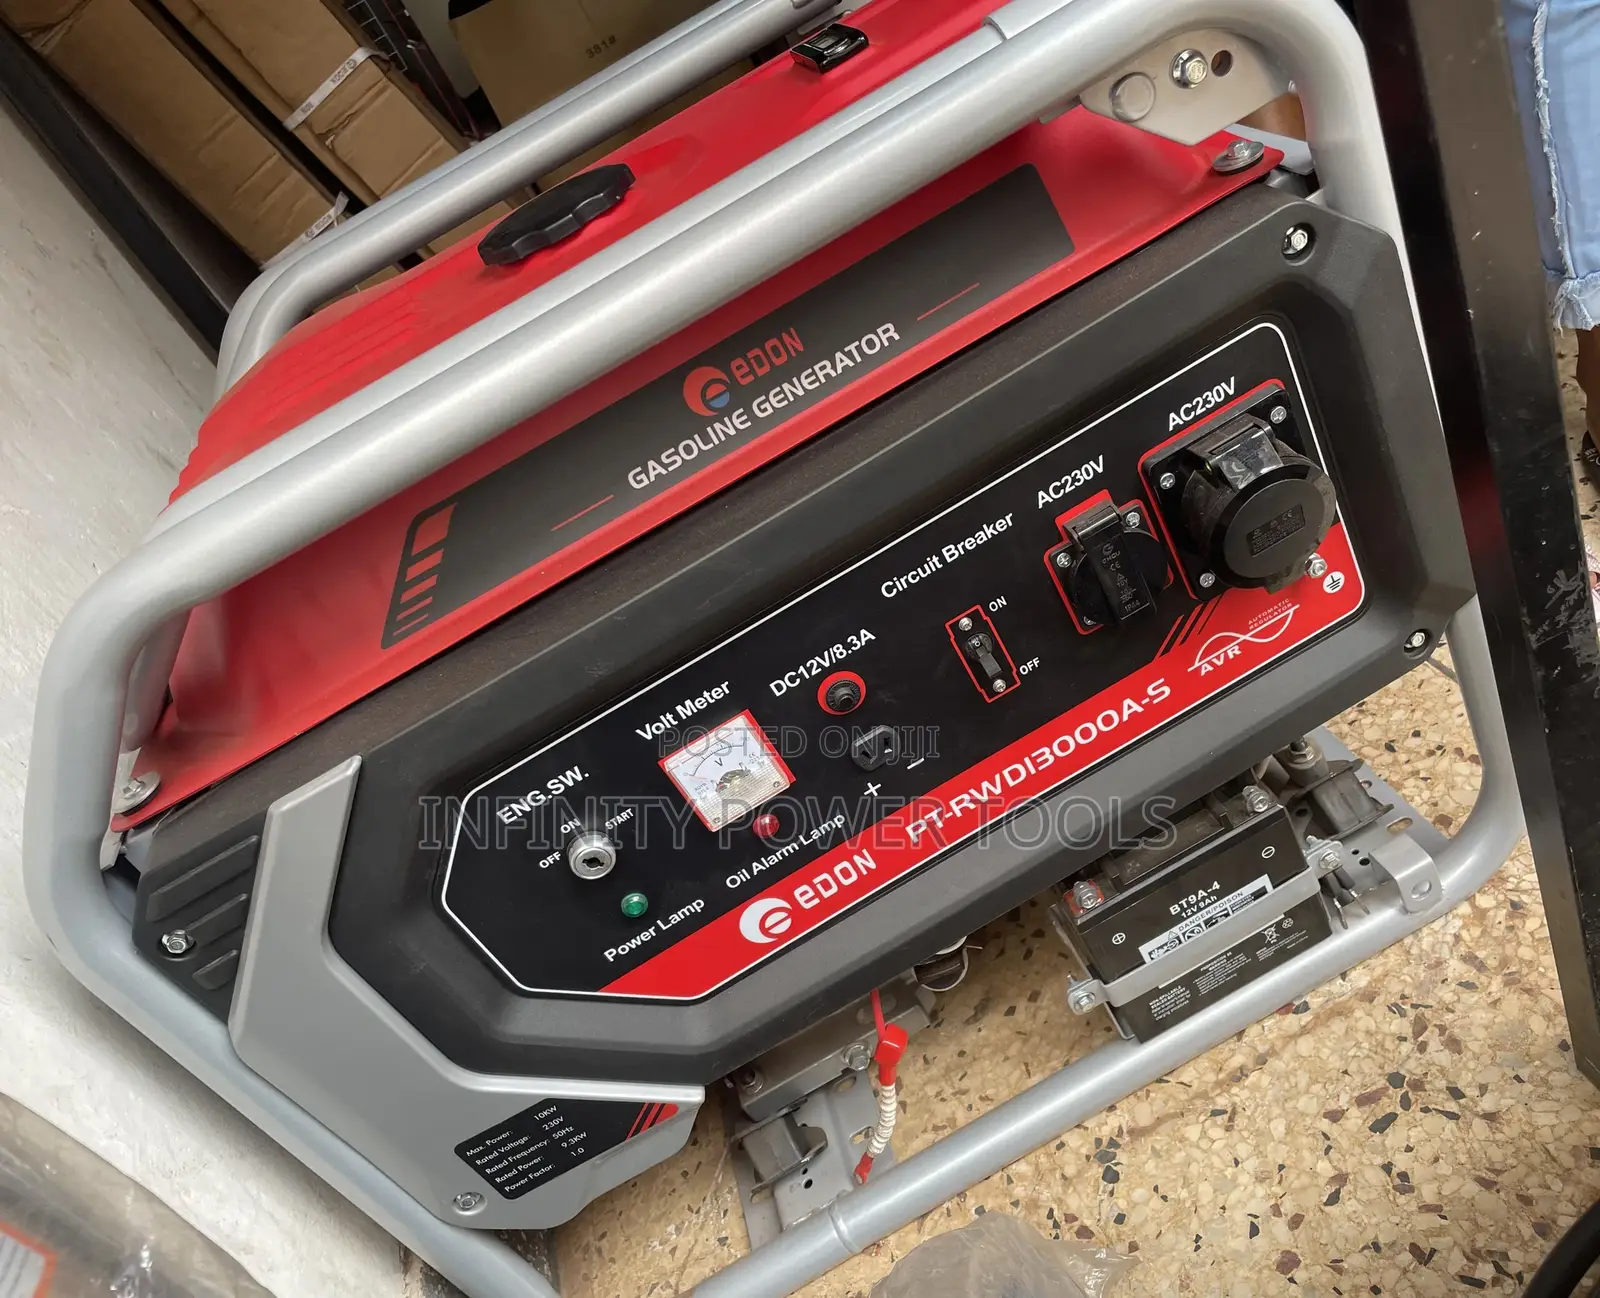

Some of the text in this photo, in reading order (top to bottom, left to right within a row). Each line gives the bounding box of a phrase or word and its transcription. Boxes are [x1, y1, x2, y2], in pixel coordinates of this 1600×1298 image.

[627, 322, 900, 489] GASOLINE GENERATOR
[1167, 376, 1236, 432] AC230V
[1036, 454, 1106, 509] AC230V
[880, 512, 1015, 599] Circuit Breaker
[989, 596, 1007, 611] ON
[1248, 598, 1290, 625] AUTOMATIC
[1249, 603, 1292, 630] REGULATOR
[768, 627, 877, 699] DC12V/8.3A
[1020, 657, 1040, 675] OFF
[1201, 645, 1242, 676] AVR
[635, 680, 732, 743] Volt Meter
[714, 757, 723, 767] V
[496, 765, 590, 825] ENG.SW.
[560, 818, 581, 834] ON
[605, 808, 635, 831] START
[539, 851, 562, 869] OFF
[725, 812, 847, 890] Oil Alarm Lamp
[1169, 880, 1221, 916] BT9A-4
[1178, 891, 1244, 932] DANGER/POISON
[1180, 904, 1198, 919] 12V
[1199, 894, 1218, 909] 9Ah
[603, 897, 706, 963] Power Lamp
[533, 1105, 557, 1121] 10KW
[542, 1116, 564, 1131] 230V
[466, 1130, 513, 1157] Max. Power:
[475, 1135, 531, 1165] Rated Voltage:
[485, 1126, 574, 1175] Rated Frequency: 50Hz
[561, 1131, 587, 1148] 9.3KW
[570, 1147, 585, 1157] 1.0
[495, 1155, 544, 1183] Rated Power:
[504, 1163, 556, 1192] Power Factor:
